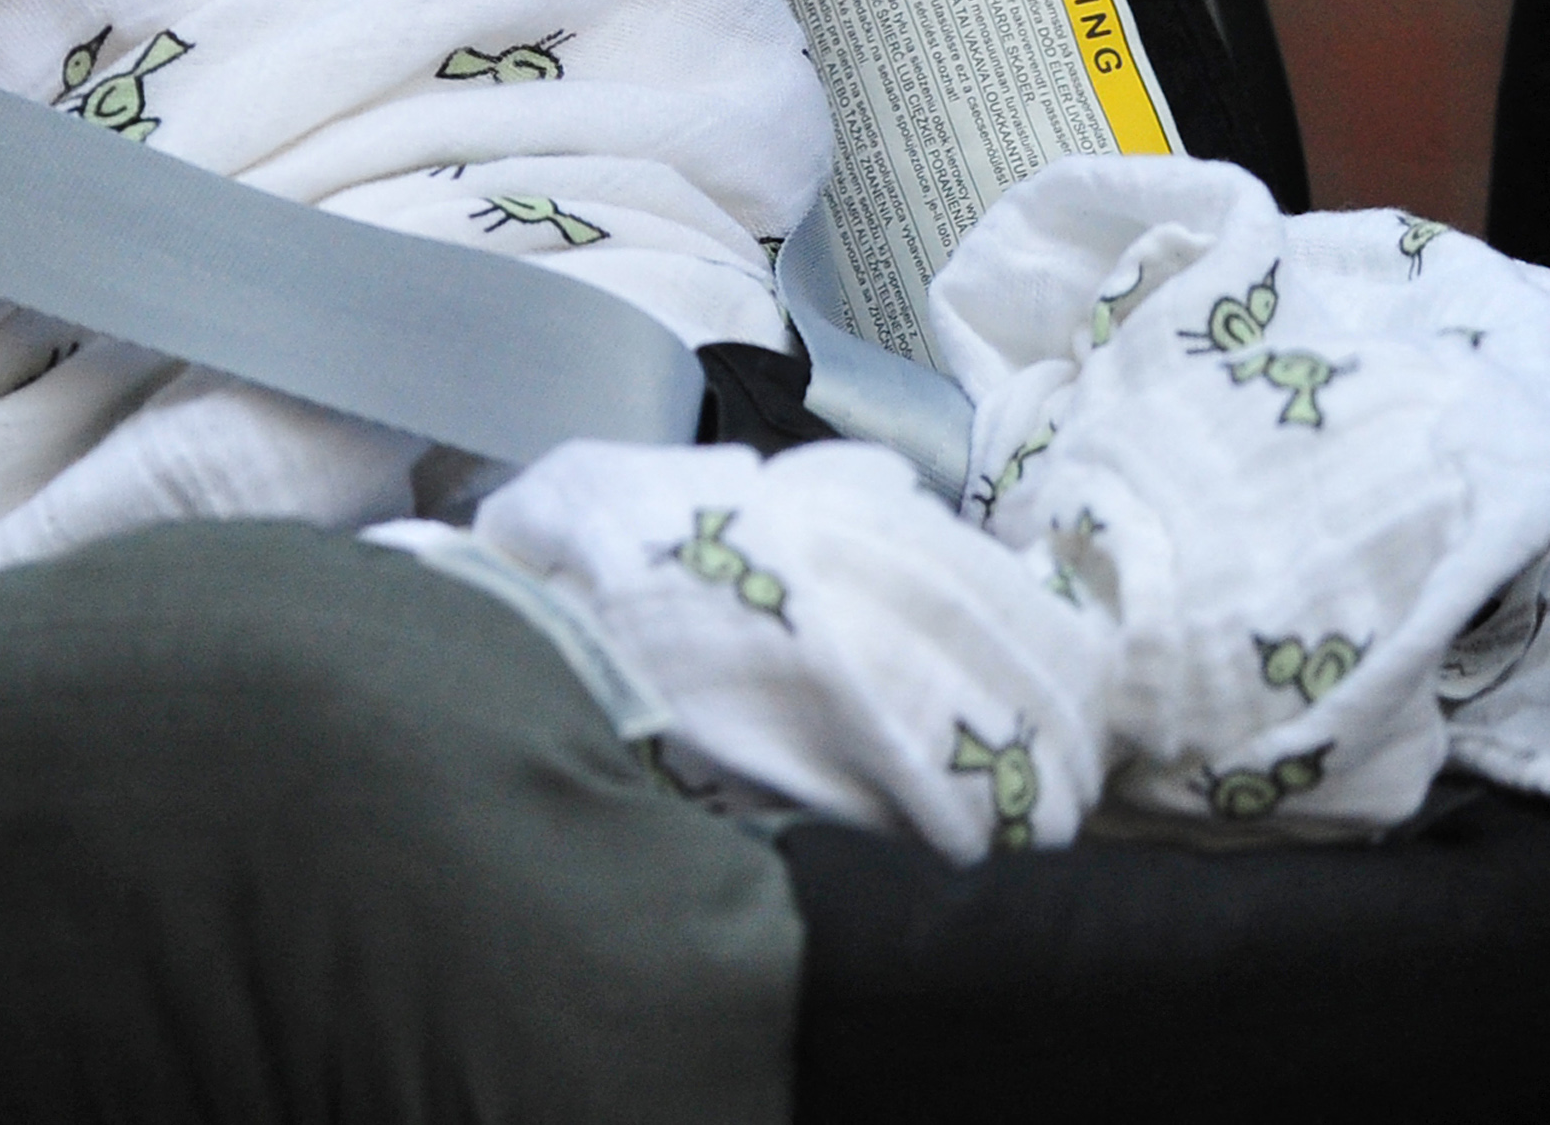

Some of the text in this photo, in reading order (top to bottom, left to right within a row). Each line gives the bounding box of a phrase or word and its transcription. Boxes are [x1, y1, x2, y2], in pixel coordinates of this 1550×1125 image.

[954, 7, 971, 29] TAI
[895, 62, 916, 92] LUB
[954, 62, 971, 83] ezt
[962, 29, 990, 81] VAKAVA
[969, 2, 1012, 95] menosuuntaan
[1005, 43, 1038, 107] SKADER.
[824, 61, 851, 109] ALEBO
[825, 24, 841, 47] pre
[855, 98, 881, 149] sedadle
[1048, 58, 1073, 103] ELLER
[876, 62, 903, 113] sedadle
[934, 221, 953, 248] toto
[909, 54, 939, 114] siedzeniu
[930, 113, 952, 146] obok
[941, 146, 972, 202] kierowcy
[854, 226, 870, 247] ALI
[875, 281, 903, 334] TELESNE
